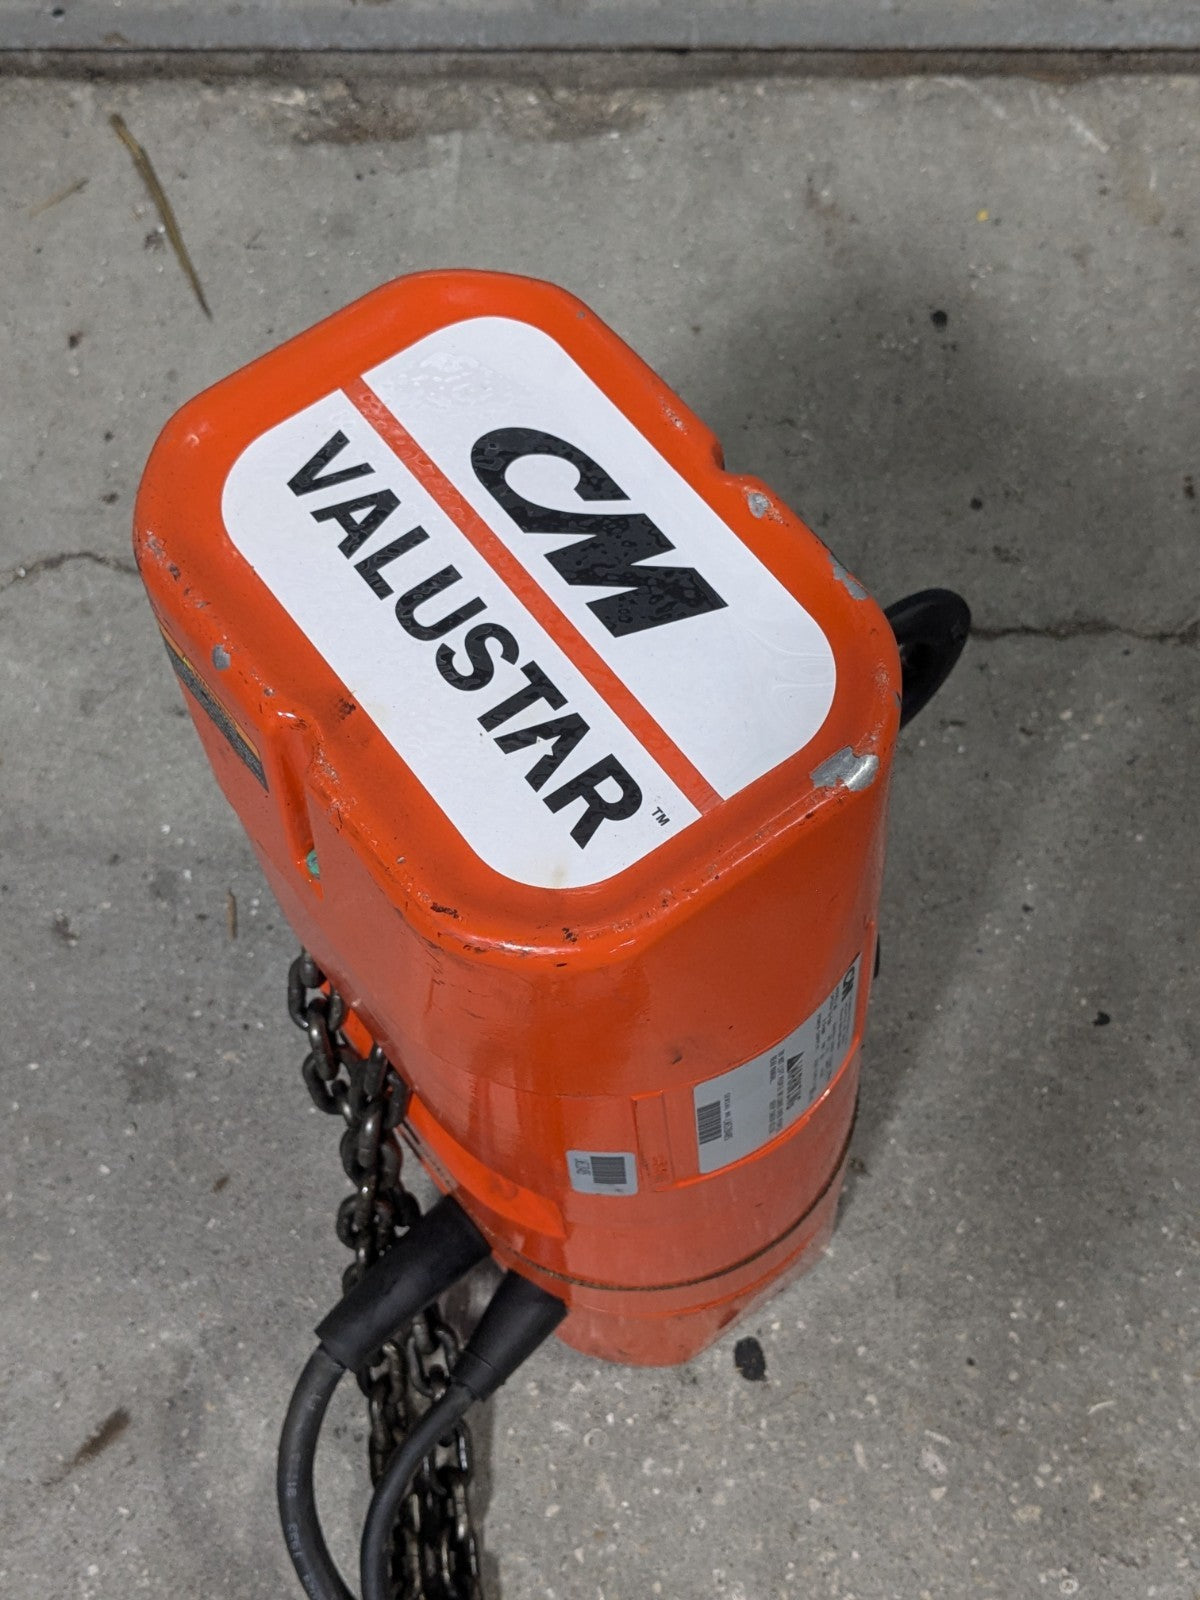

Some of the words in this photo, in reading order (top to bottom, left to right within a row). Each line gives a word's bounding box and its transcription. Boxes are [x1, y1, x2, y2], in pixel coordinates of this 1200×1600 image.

[286, 430, 643, 850] VALUSTAR
[651, 806, 670, 828] TM
[471, 427, 729, 638] CM
